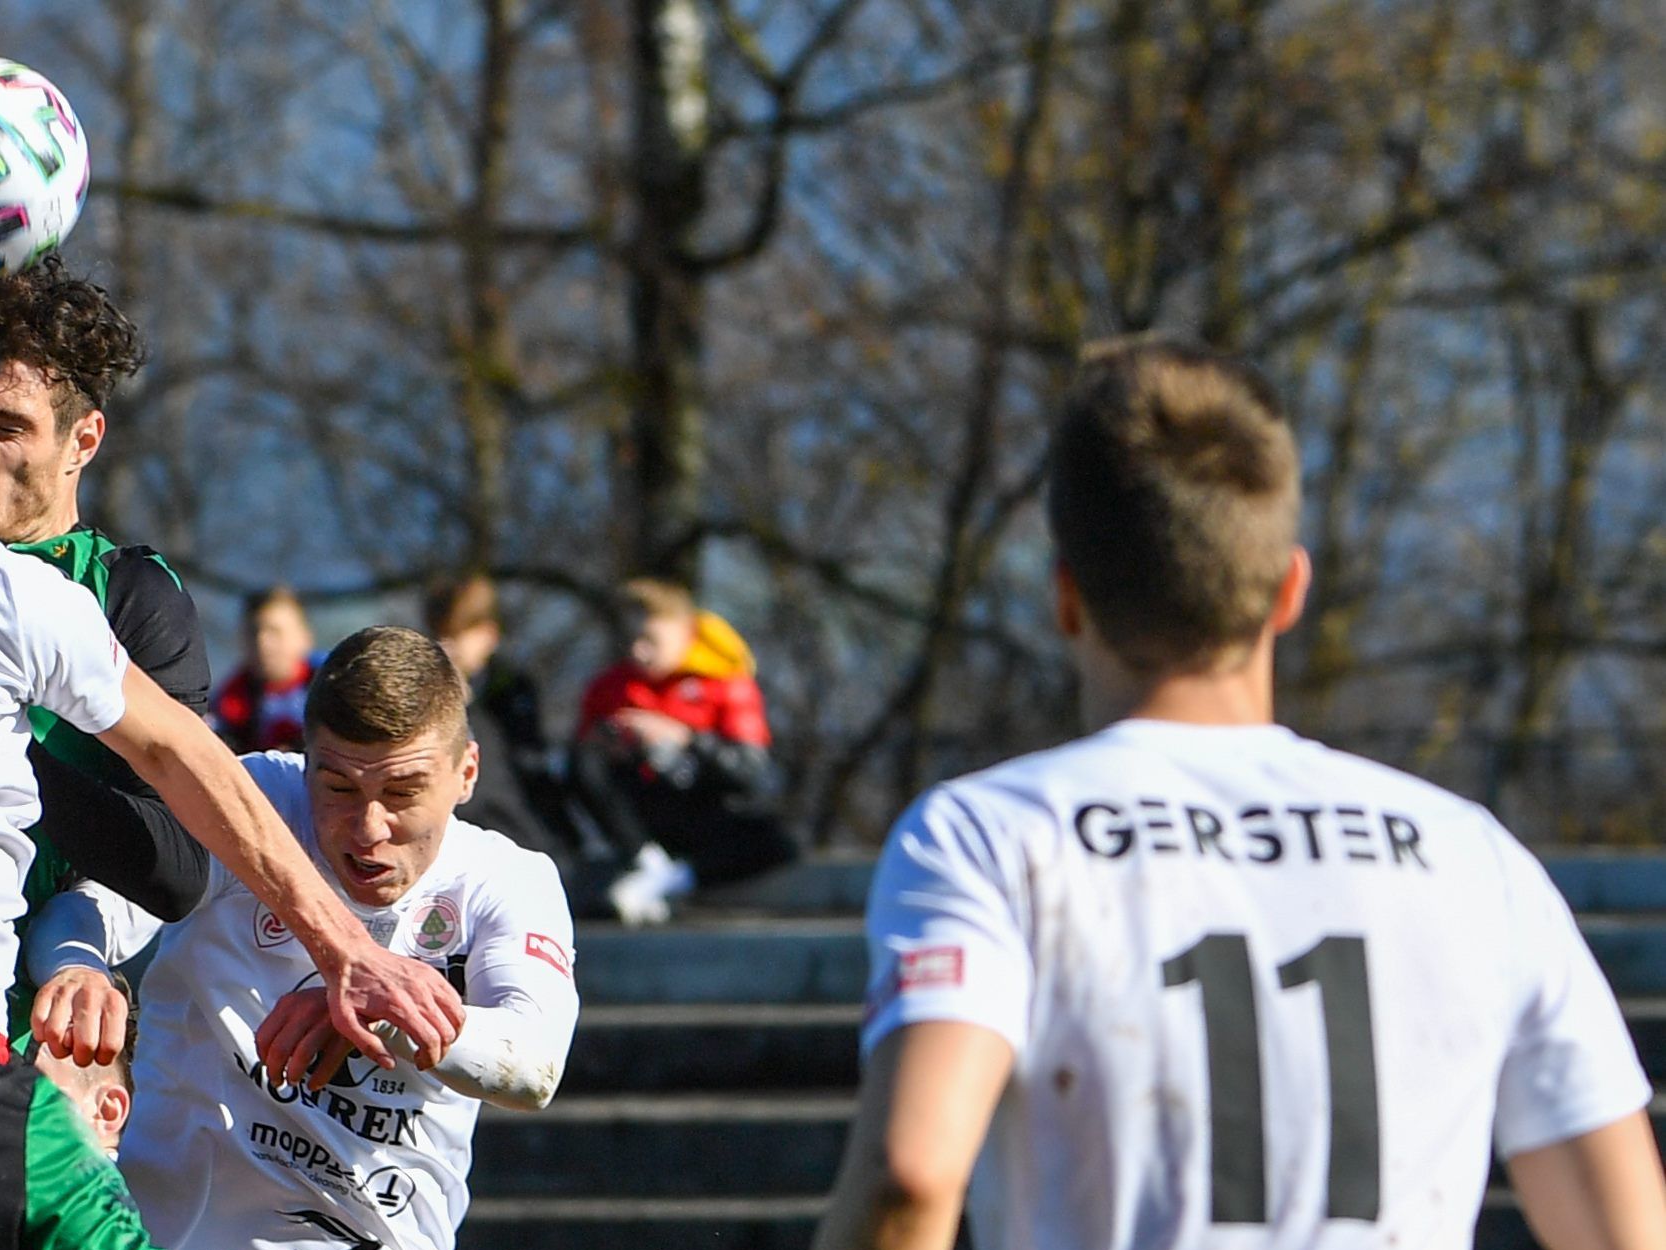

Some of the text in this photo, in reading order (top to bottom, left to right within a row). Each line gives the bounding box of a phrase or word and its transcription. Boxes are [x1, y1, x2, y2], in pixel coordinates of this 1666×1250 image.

[1074, 800, 1429, 870] GERSTER
[371, 1076, 406, 1097] 1834
[1161, 933, 1381, 1224] 11
